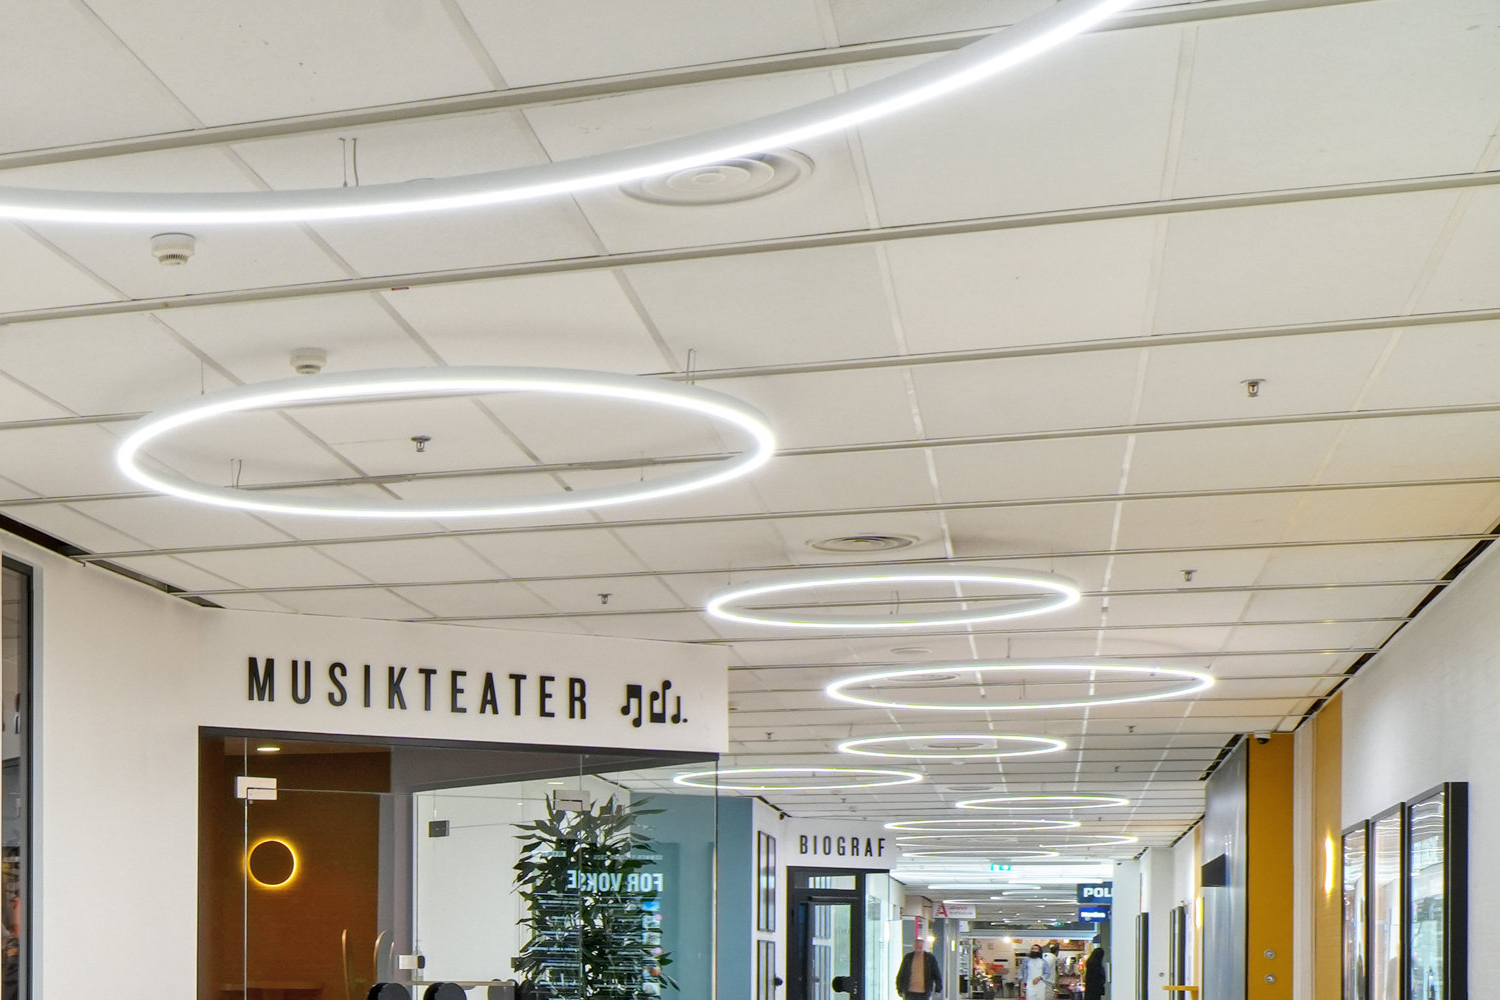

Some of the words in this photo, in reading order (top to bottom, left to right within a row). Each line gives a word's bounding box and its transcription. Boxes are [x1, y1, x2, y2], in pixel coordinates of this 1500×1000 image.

[247, 656, 587, 720] MUSIKTEATER
[799, 834, 886, 857] BIOGRAF
[1083, 887, 1113, 898] POL
